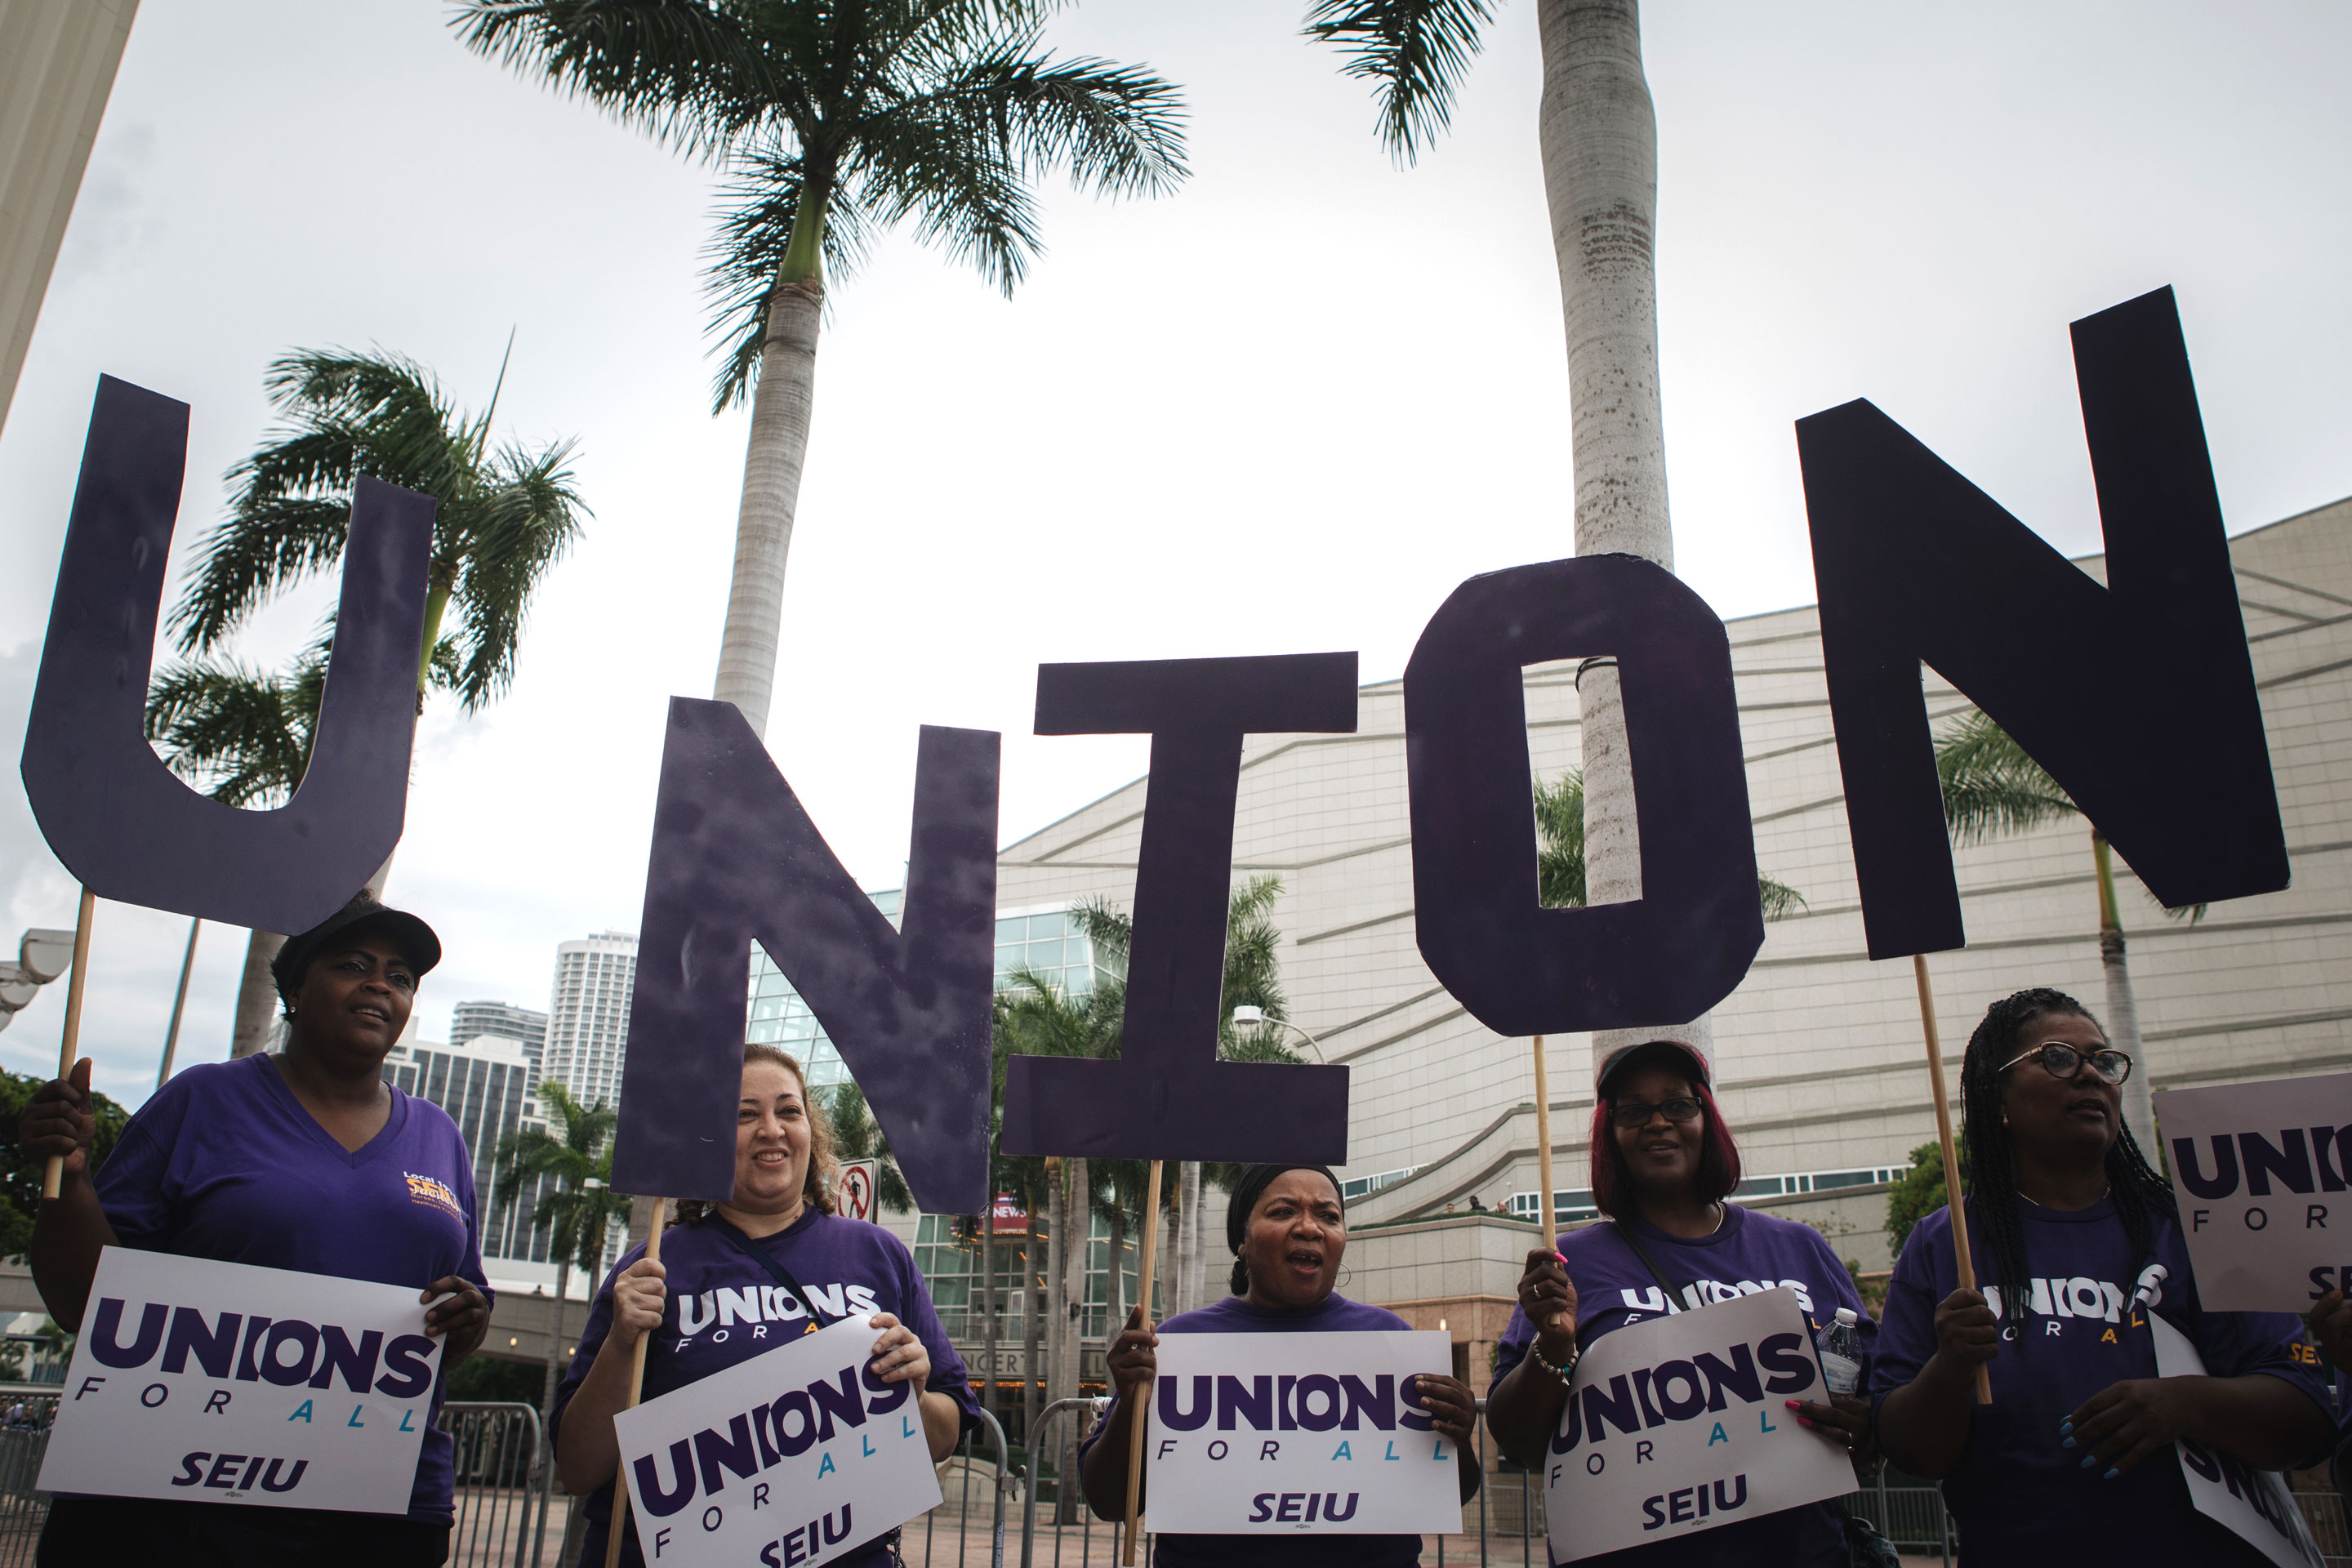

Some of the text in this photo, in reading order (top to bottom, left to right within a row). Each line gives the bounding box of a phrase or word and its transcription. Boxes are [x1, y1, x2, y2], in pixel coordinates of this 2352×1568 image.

[403, 1170, 434, 1184] Local
[2193, 1204, 2328, 1233] FOR
[678, 1282, 882, 1336] UNIONS
[2002, 1311, 2145, 1344] OR AL
[89, 1297, 438, 1399] UNIONS
[675, 1325, 768, 1353] FOR
[2288, 1343, 2323, 1365] SE
[960, 1354, 1025, 1372] NCER
[74, 1376, 416, 1432] FOR ALL
[1157, 1373, 1449, 1432] UNIONS
[633, 1350, 911, 1517] UNIONS
[1157, 1440, 1449, 1460] FOR ALL
[171, 1451, 310, 1494] SEIU
[655, 1415, 915, 1559] FOR ALL
[1550, 1440, 1655, 1489] FOR
[1249, 1492, 1360, 1523] SEIU
[1642, 1473, 1748, 1531] SEIU
[760, 1503, 853, 1568] SEIU
